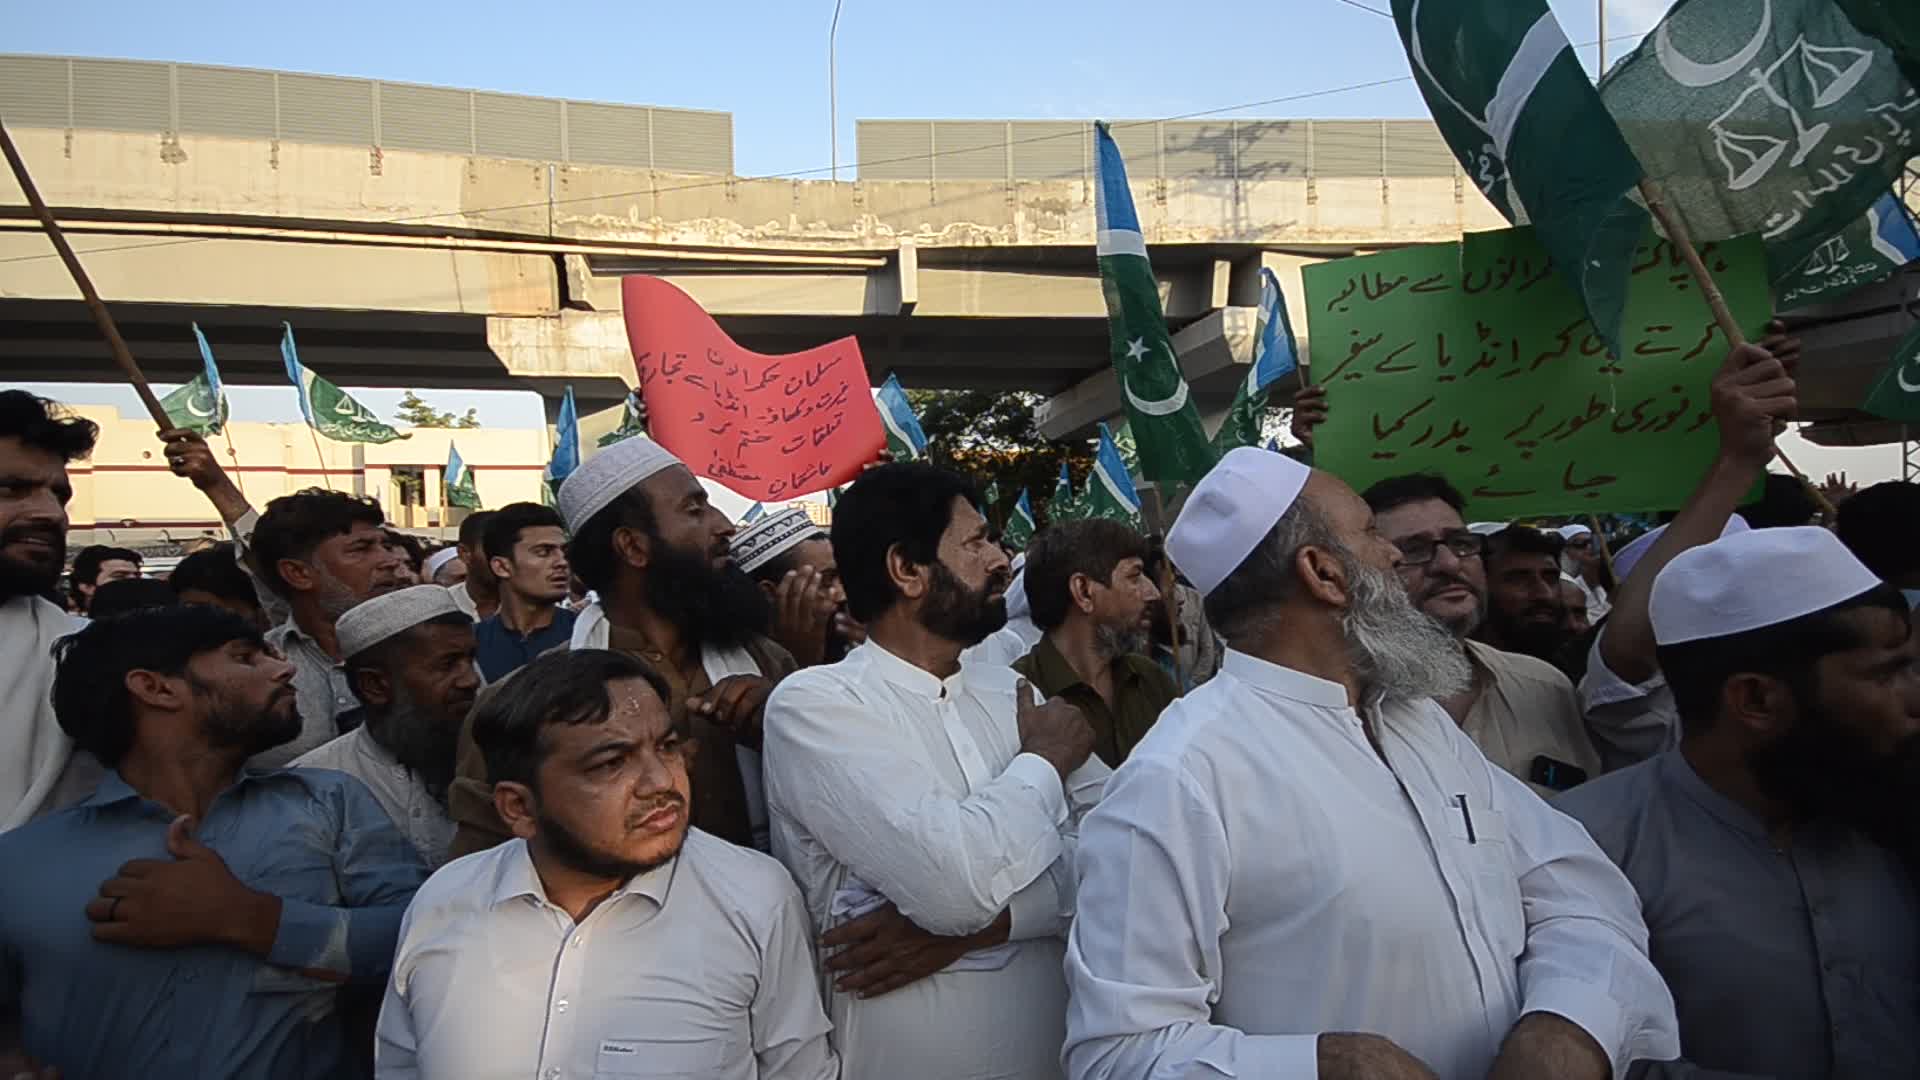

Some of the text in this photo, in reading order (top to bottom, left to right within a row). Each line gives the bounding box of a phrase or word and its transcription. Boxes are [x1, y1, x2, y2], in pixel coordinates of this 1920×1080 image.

[1327, 271, 1409, 313] مطالبہ
[1408, 273, 1454, 294] سے
[1320, 328, 1384, 384] سفیر
[1374, 340, 1418, 373] کے
[682, 373, 711, 391] سے
[814, 380, 849, 411] غیرت
[1370, 396, 1436, 460] کیا
[1540, 392, 1608, 442] طور
[1611, 384, 1690, 436] فوری
[737, 429, 773, 458] ختم
[781, 411, 844, 455] تعلقات
[1409, 418, 1473, 455] بدر
[1503, 403, 1546, 461] پر
